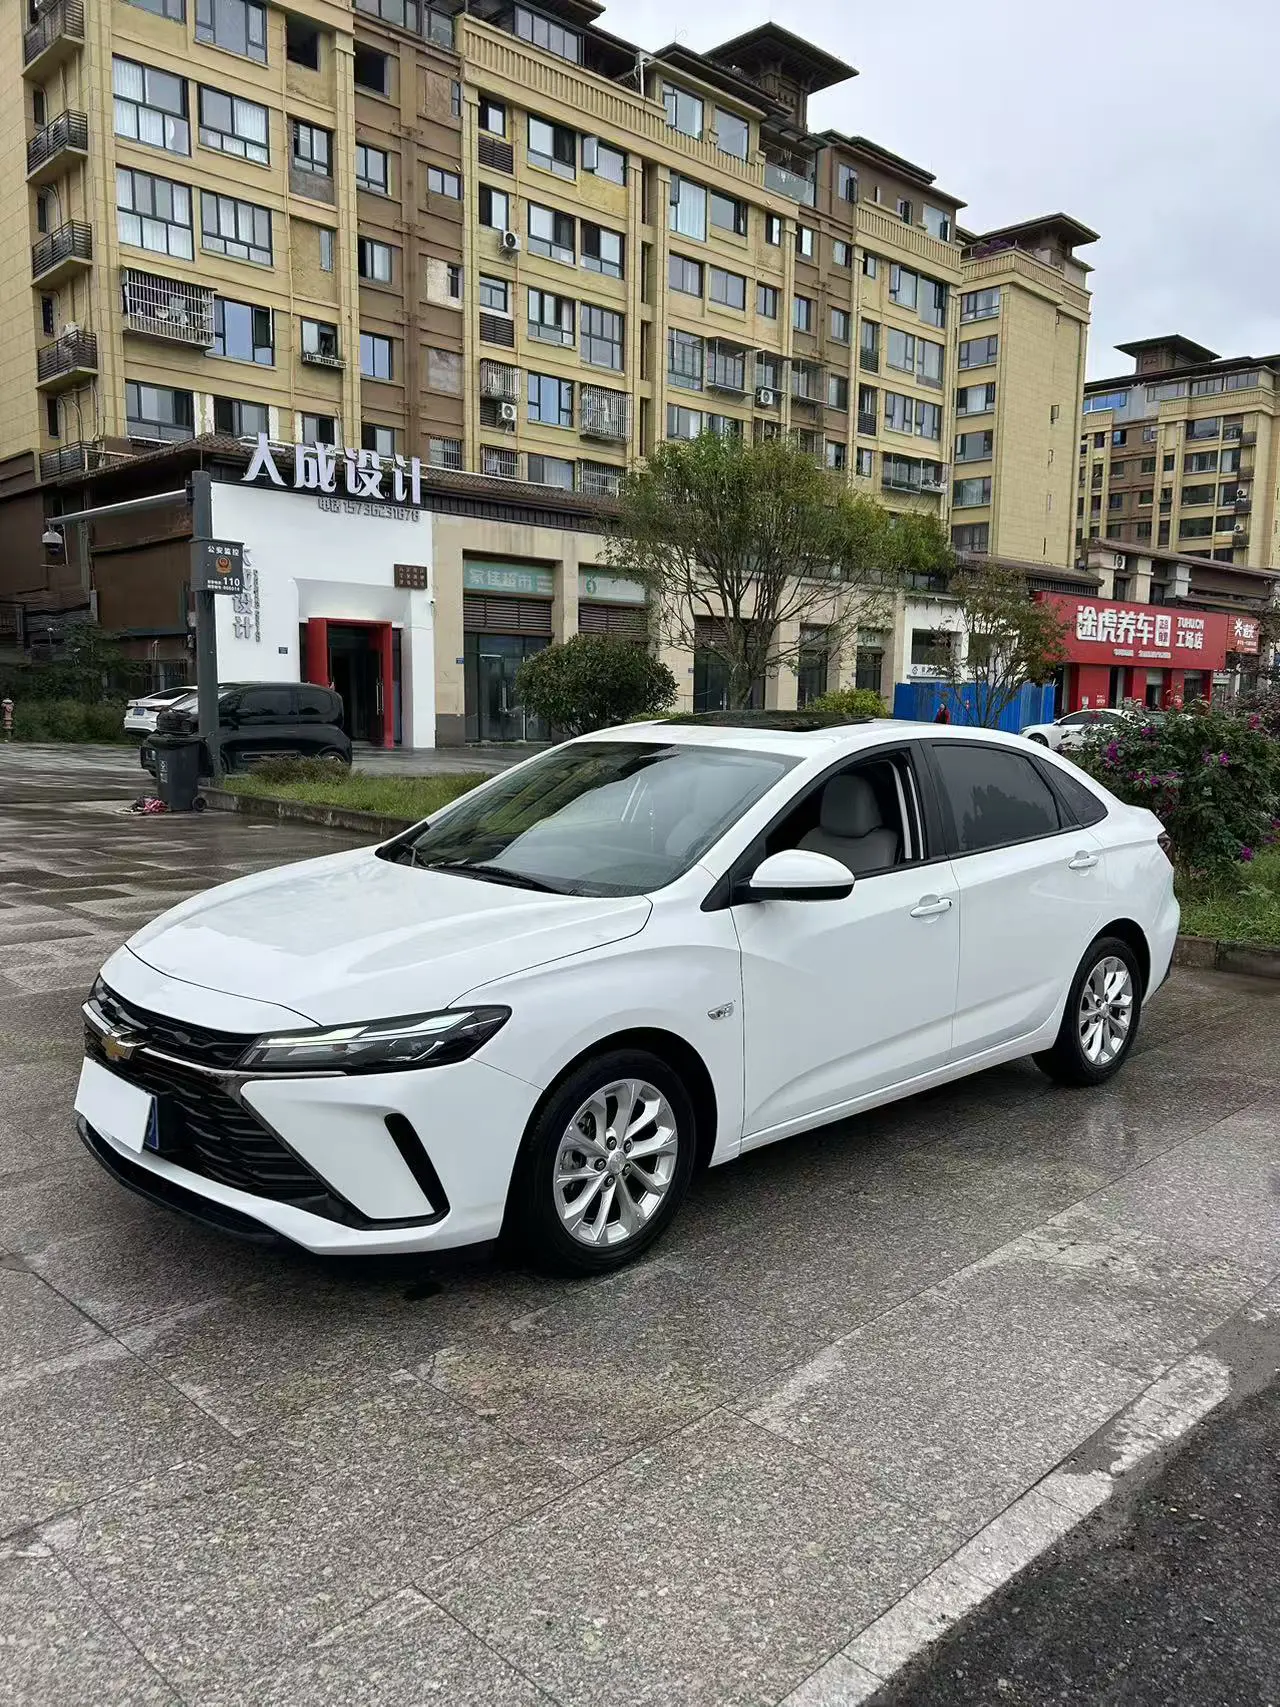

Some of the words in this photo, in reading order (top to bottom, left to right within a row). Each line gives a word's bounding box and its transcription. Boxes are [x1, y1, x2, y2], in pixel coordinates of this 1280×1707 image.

[240, 432, 428, 504] 大成设计
[207, 545, 240, 557] 公安监控
[223, 576, 241, 587] 110
[1076, 605, 1155, 646] 途虎养车
[1175, 630, 1204, 649] 工场店
